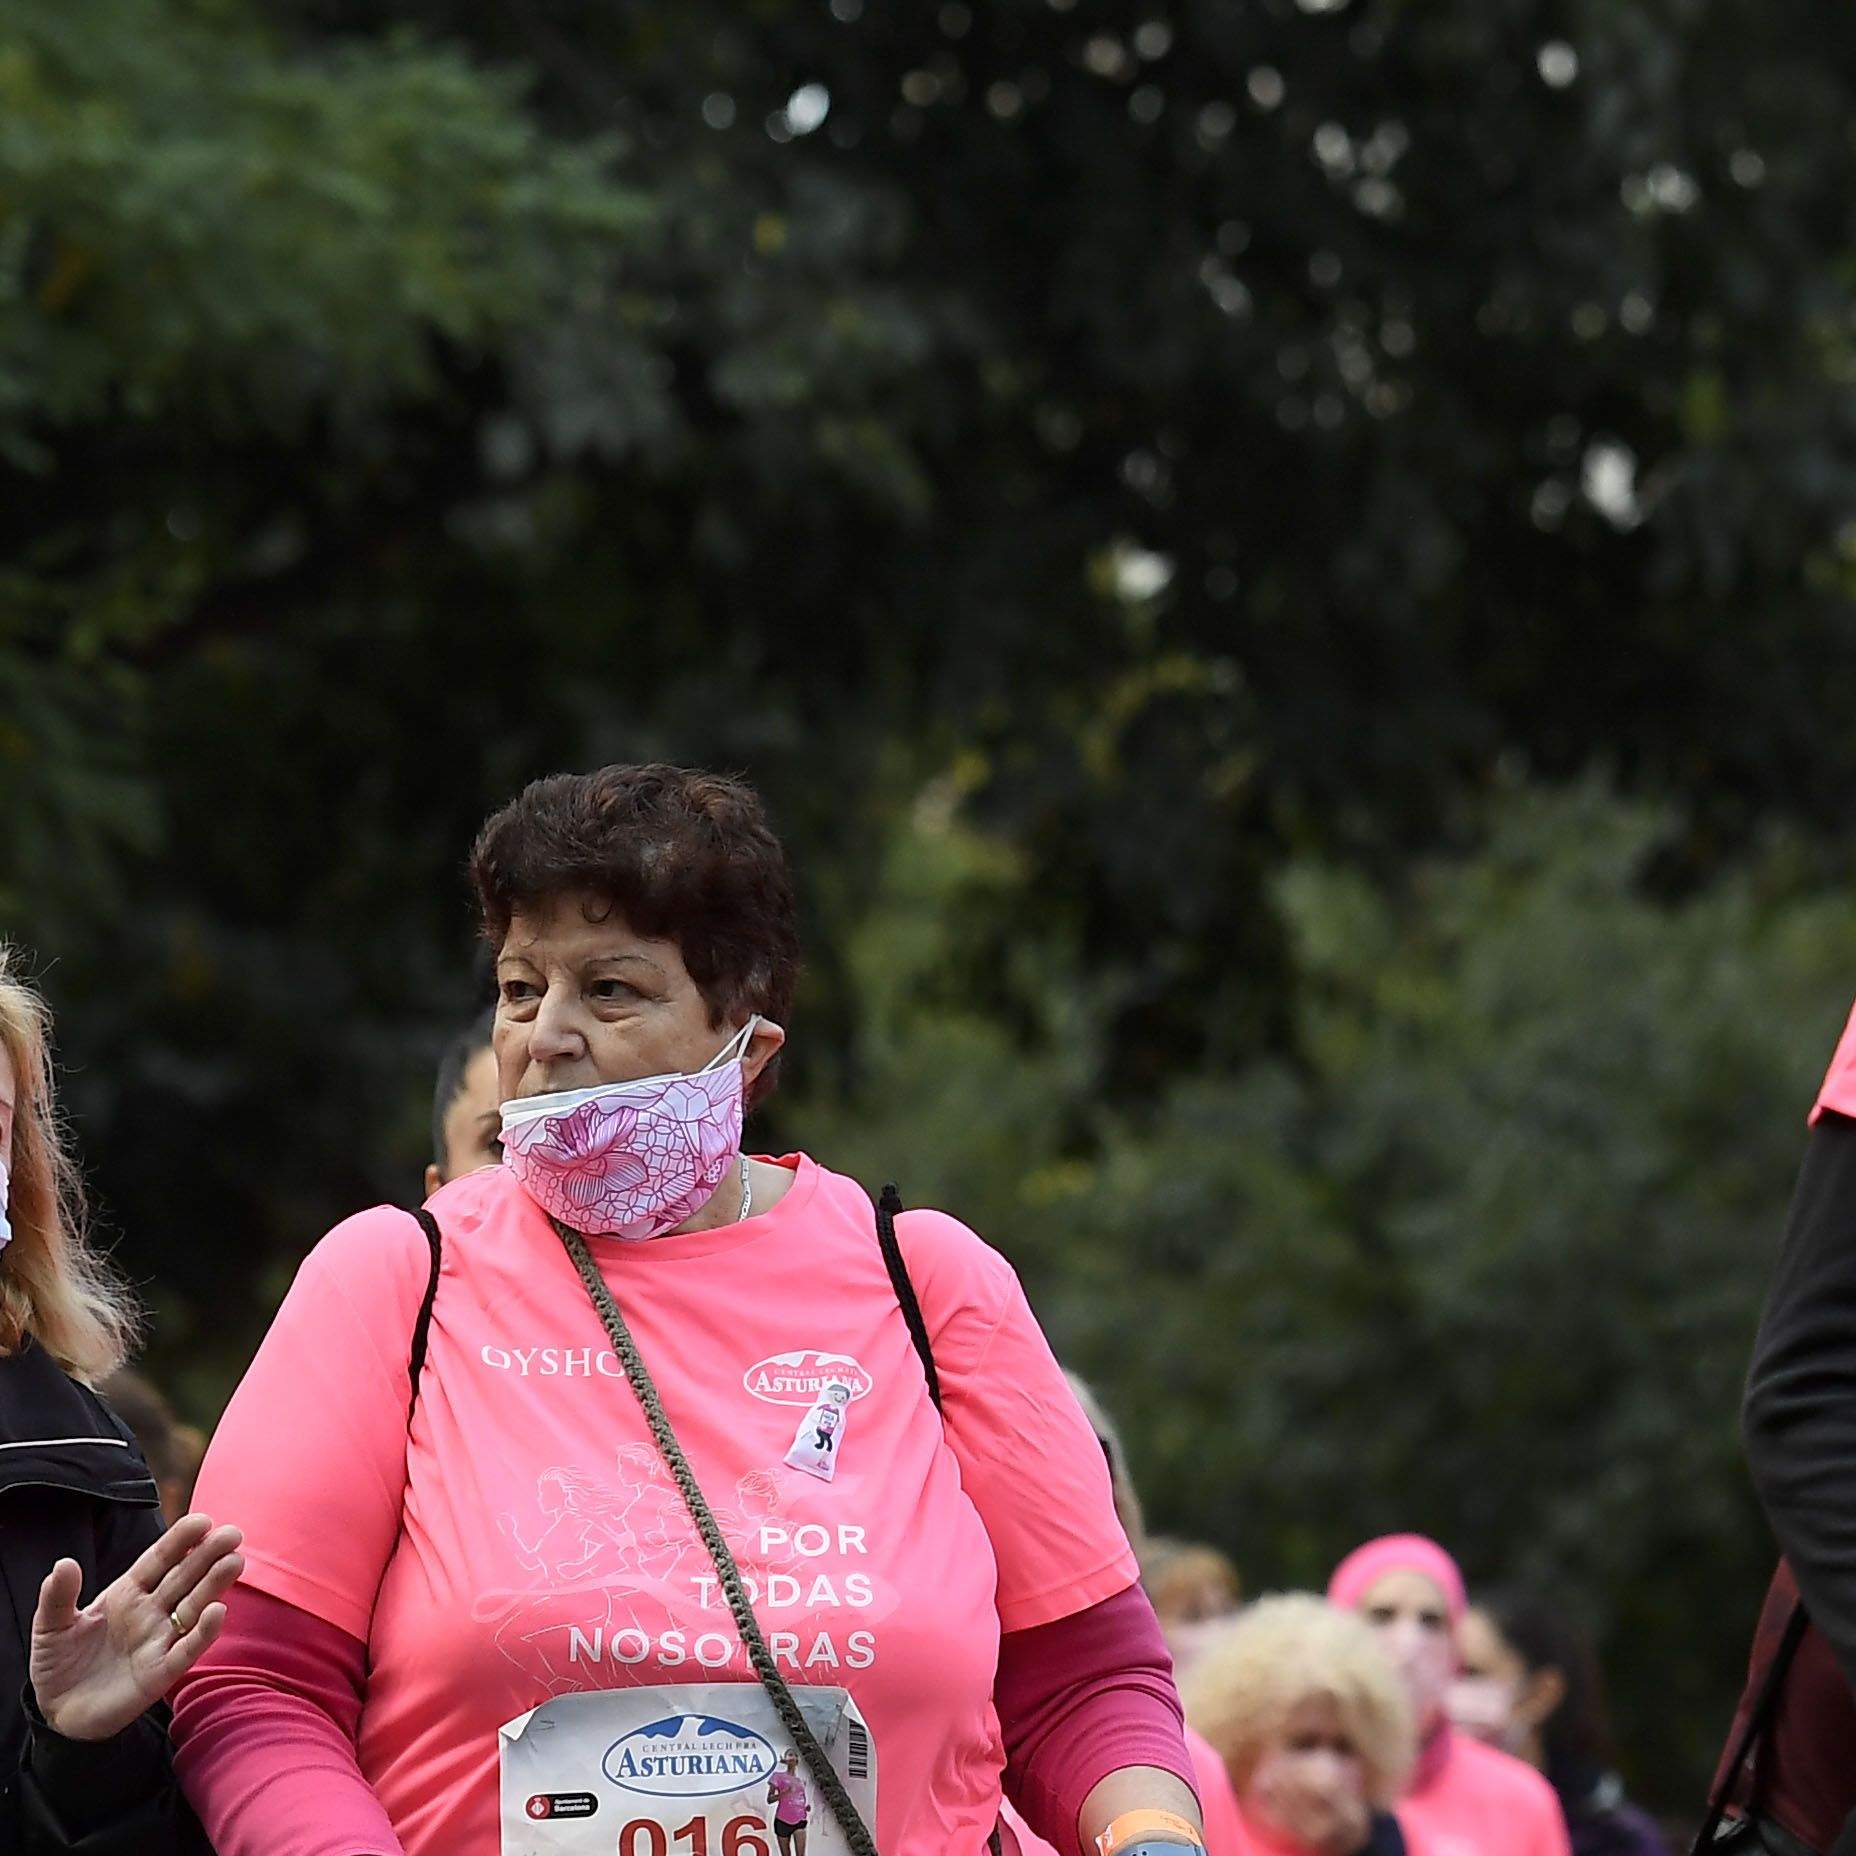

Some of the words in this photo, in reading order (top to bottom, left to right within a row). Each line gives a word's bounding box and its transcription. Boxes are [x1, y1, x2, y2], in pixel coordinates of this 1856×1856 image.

[760, 1524, 867, 1557] POR
[569, 1626, 876, 1668] NOSORAS
[615, 1747, 765, 1778] ASTURIANA
[642, 1741, 697, 1753] CENTRAL
